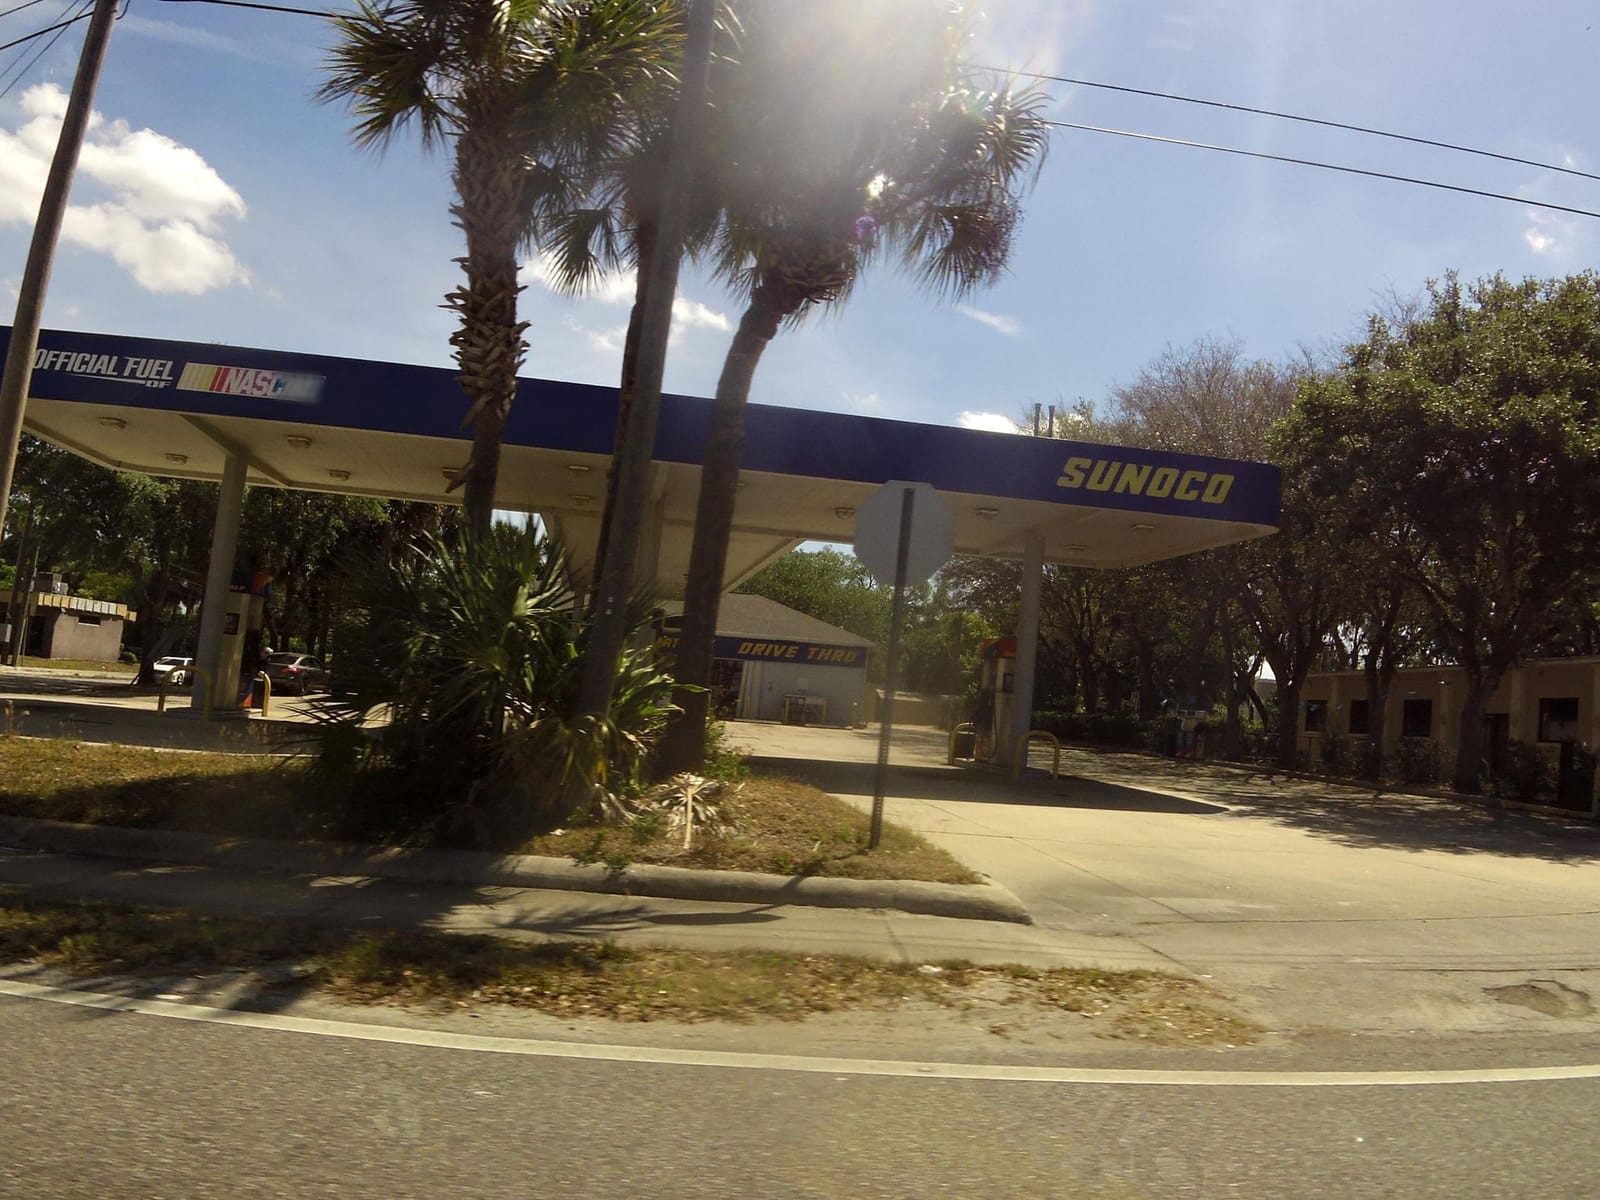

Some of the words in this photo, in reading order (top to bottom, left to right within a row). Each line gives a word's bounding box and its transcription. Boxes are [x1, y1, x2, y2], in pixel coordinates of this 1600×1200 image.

[34, 348, 118, 375] OFFICIAL
[123, 356, 174, 380] FUEL
[145, 379, 172, 389] OF
[221, 366, 322, 401] NASC
[1056, 457, 1235, 504] SUNOCO
[738, 642, 799, 658] DRIVE
[807, 647, 857, 662] THRU
